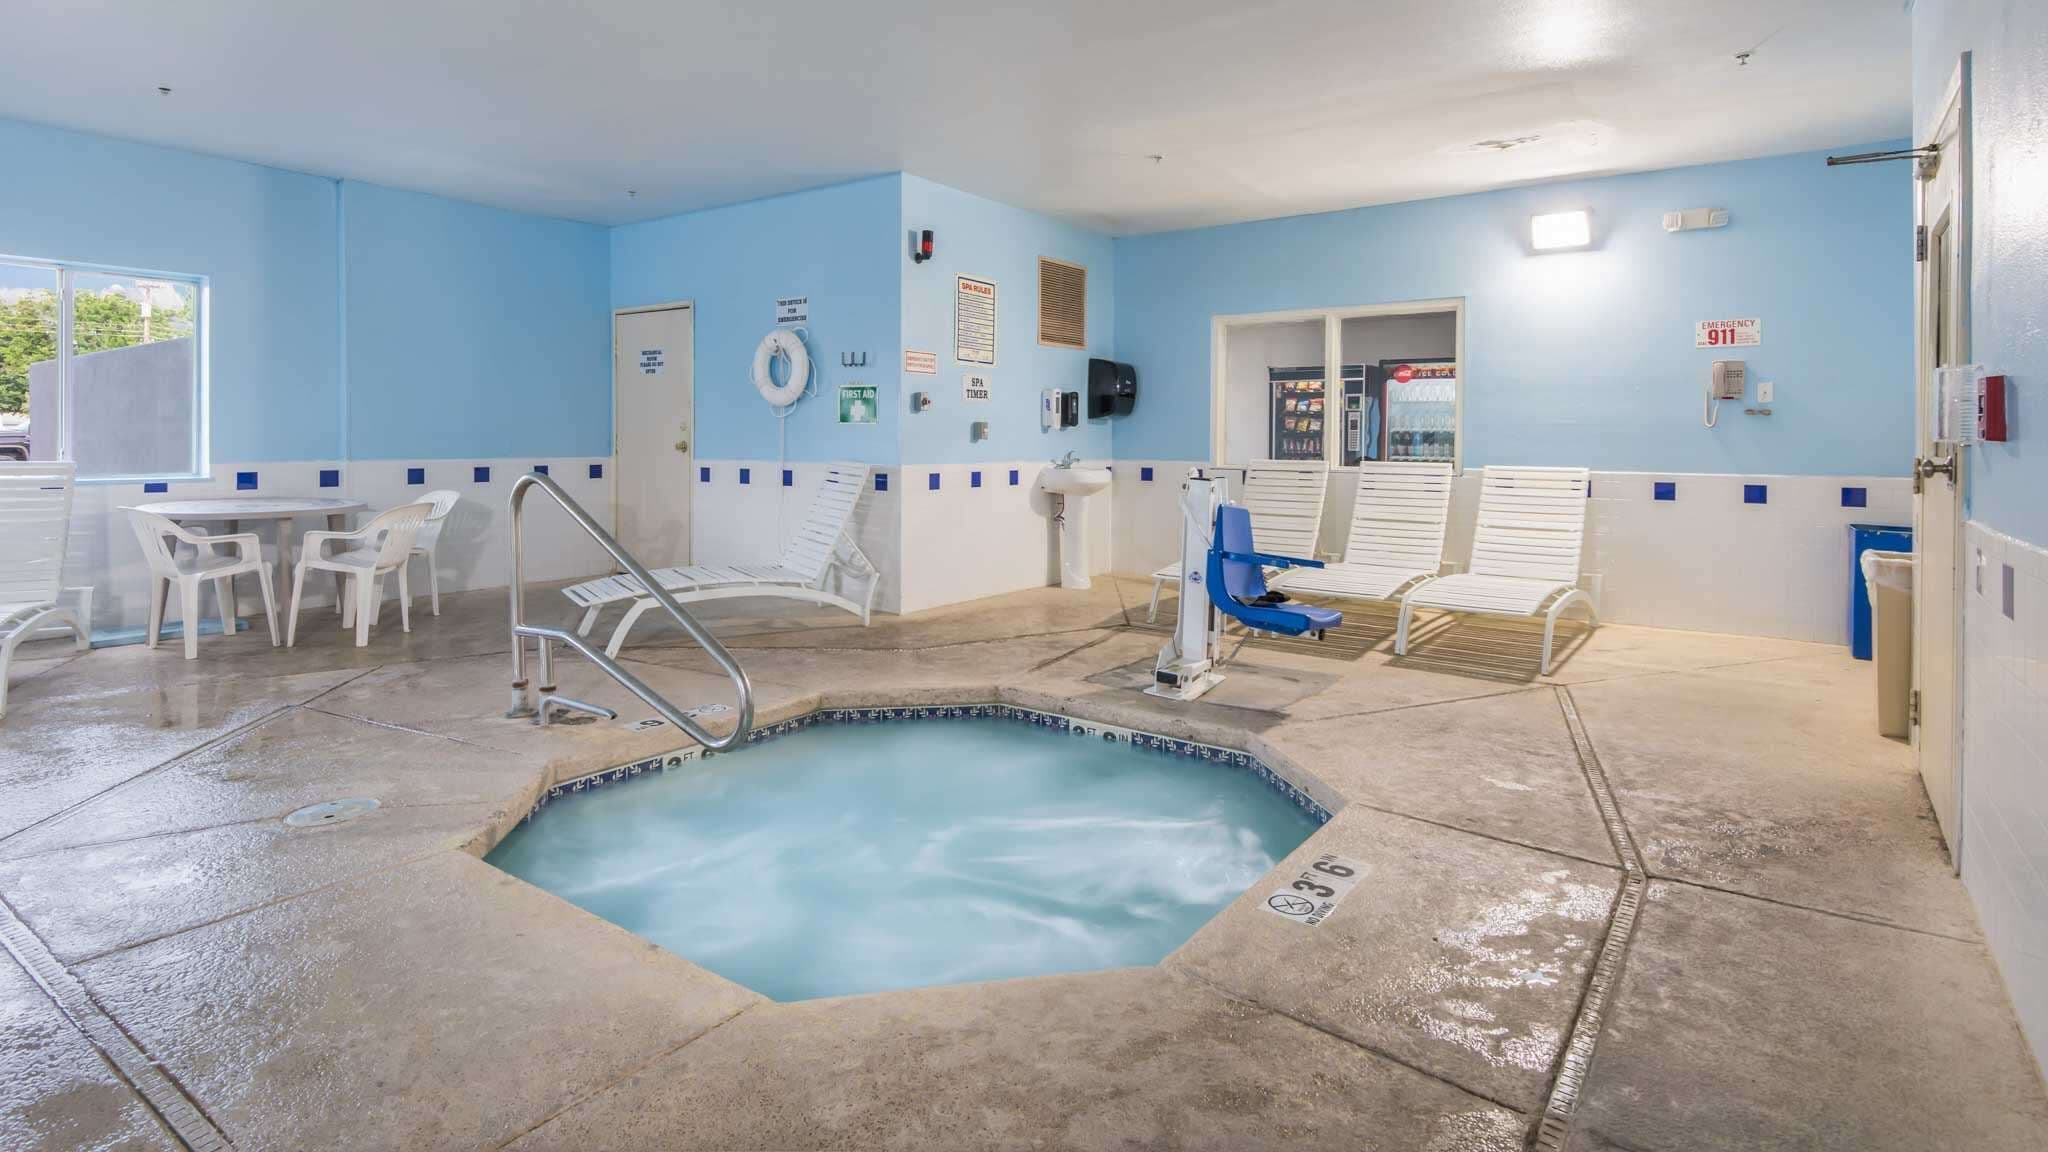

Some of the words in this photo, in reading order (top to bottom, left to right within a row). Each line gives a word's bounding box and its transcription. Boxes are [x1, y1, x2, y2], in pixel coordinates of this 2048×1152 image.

[962, 282, 973, 291] SPA
[974, 285, 992, 295] RULES
[1702, 319, 1756, 330] EMERGENCY
[1708, 328, 1736, 346] 911
[971, 377, 984, 387] SPA
[842, 389, 861, 399] FIRST
[862, 389, 875, 399] AID
[966, 389, 988, 399] TIMER
[683, 751, 695, 762] FT
